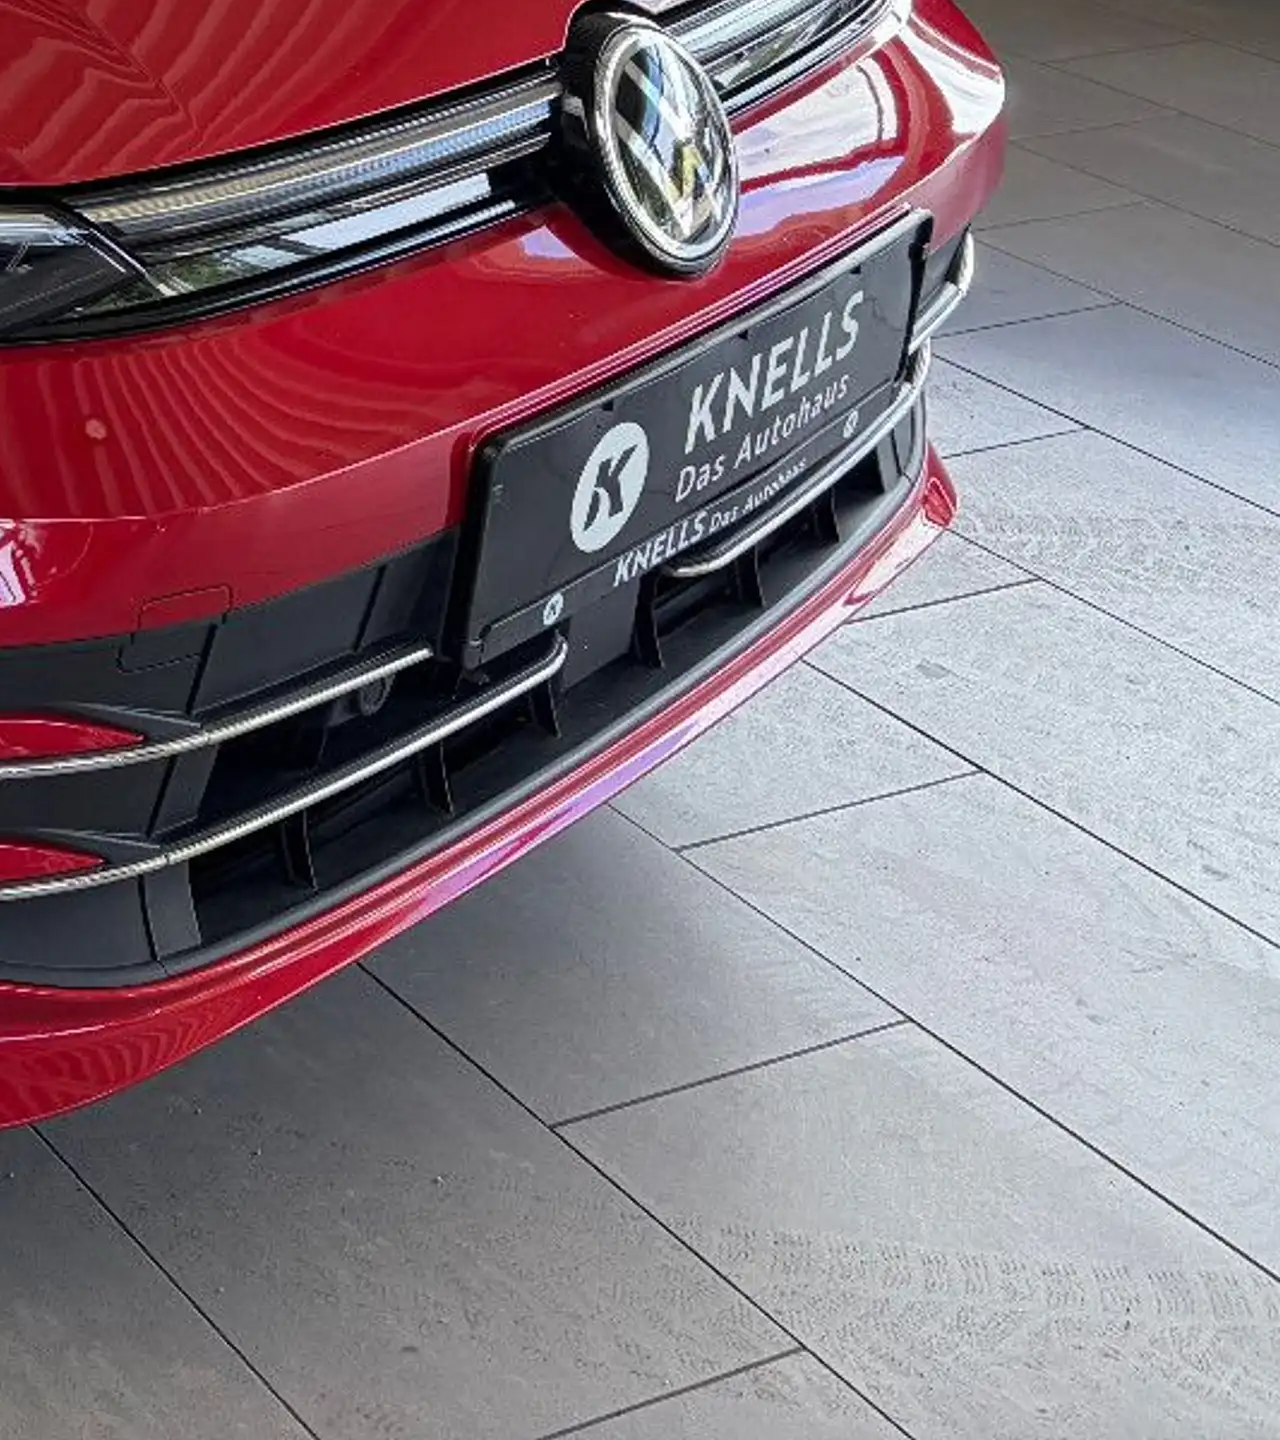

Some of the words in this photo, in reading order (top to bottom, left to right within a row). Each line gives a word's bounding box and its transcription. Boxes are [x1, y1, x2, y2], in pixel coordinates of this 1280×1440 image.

[684, 289, 865, 454] KNELLS
[579, 440, 642, 536] K
[674, 453, 726, 502] Das
[732, 375, 849, 470] Autohaus
[613, 509, 708, 588] KNELLS
[708, 505, 740, 534] Das
